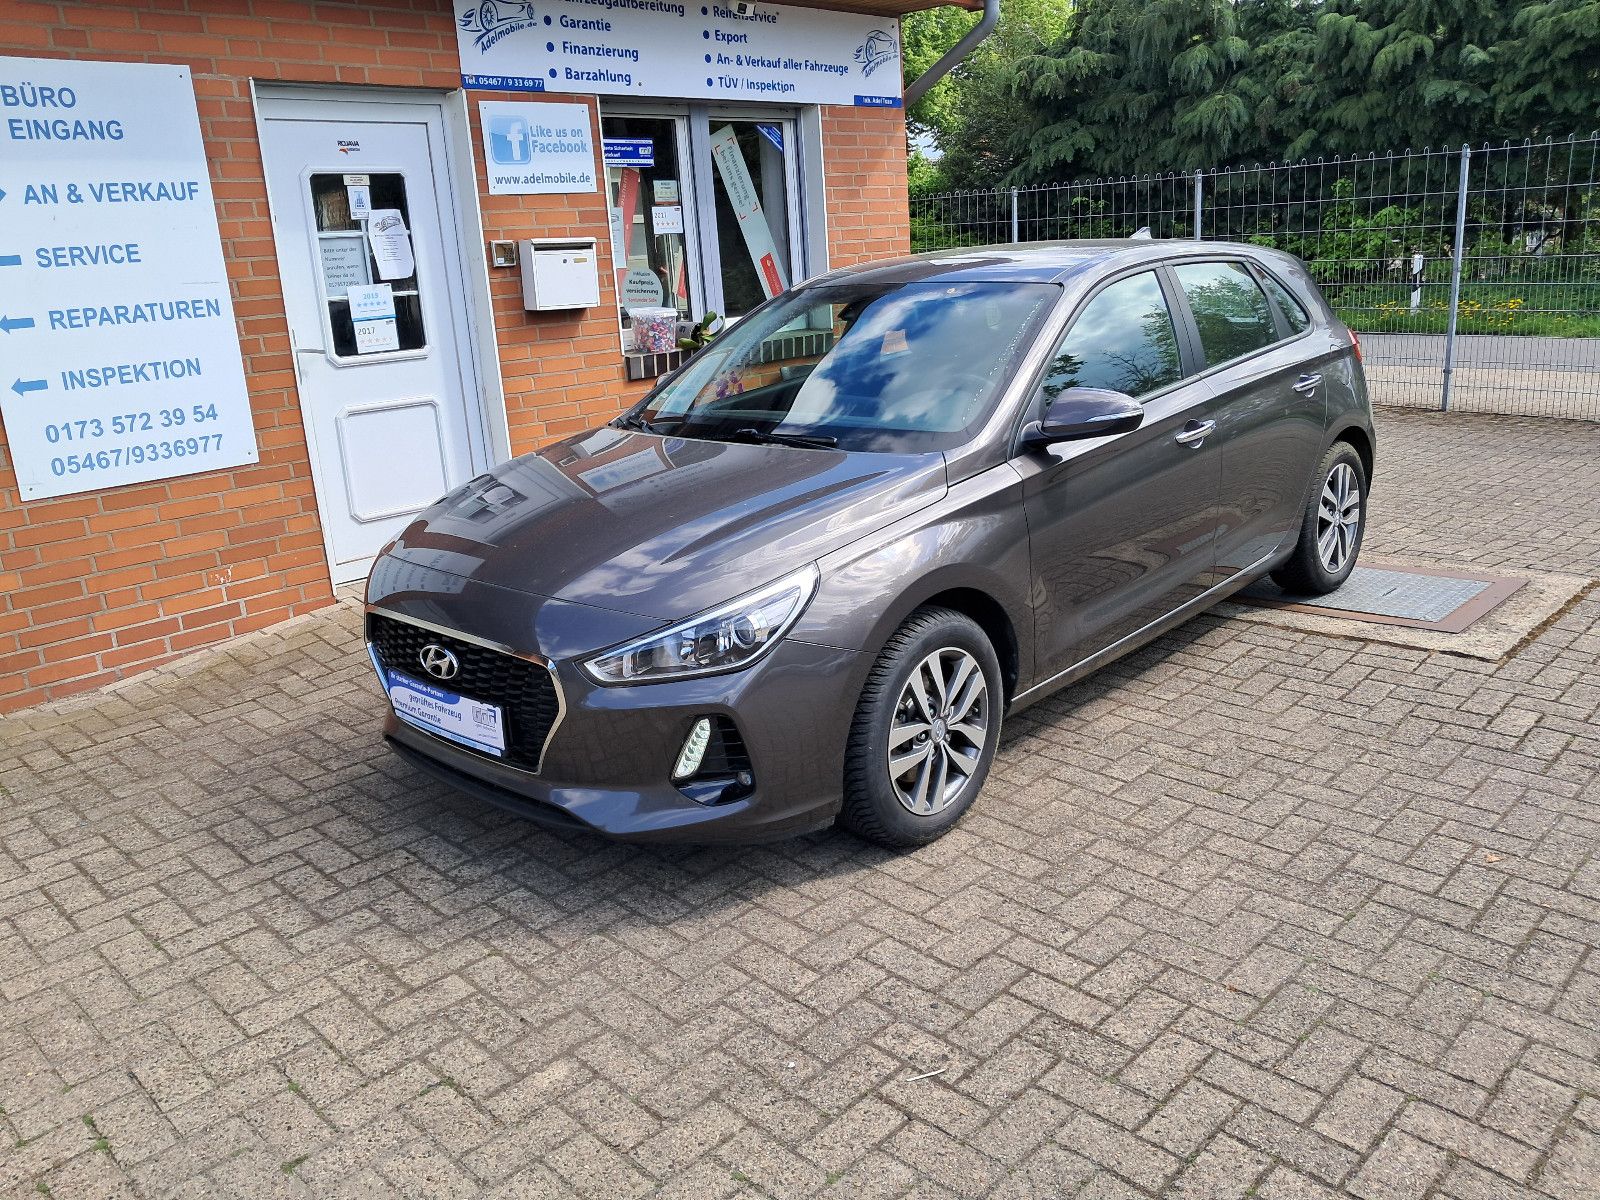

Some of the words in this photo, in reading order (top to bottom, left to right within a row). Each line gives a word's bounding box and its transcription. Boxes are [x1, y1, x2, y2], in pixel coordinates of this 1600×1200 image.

[560, 15, 611, 31] Garantie
[481, 21, 538, 55] Adelmobile.de
[715, 30, 747, 44] Export
[562, 41, 639, 62] Finanzierung
[717, 53, 734, 65] An-
[736, 54, 744, 66] &
[745, 55, 782, 69] Verkauf
[783, 58, 802, 70] aller
[805, 60, 849, 76] Fahrzeuge
[464, 76, 478, 85] Tel.
[479, 77, 502, 86] 05467
[507, 78, 513, 87] 9
[514, 79, 524, 87] 33
[524, 80, 534, 88] 69
[535, 80, 544, 88] 77
[565, 67, 632, 86] Barzahlung
[718, 75, 738, 88] TÜV
[741, 78, 745, 90] /
[747, 78, 795, 93] Inspektion
[0, 82, 77, 109] BÜRO
[8, 118, 124, 141] EINGANG
[530, 125, 553, 138] Like
[555, 128, 568, 138] us
[570, 128, 583, 138] on
[531, 140, 588, 153] Facebook
[495, 173, 591, 185] www.adelmobile.de
[23, 183, 59, 205] AN
[66, 182, 84, 204] &
[88, 181, 199, 203] VERKAUF
[35, 243, 142, 268] SERVICE
[626, 288, 659, 296] versicherung
[48, 298, 221, 331] REPARATUREN
[358, 326, 376, 336] 2017
[61, 357, 202, 391] INSPEKTION
[45, 415, 104, 444] 0173
[112, 411, 152, 435] 572
[159, 408, 186, 428] 39
[193, 403, 218, 424] 54
[50, 433, 224, 477] 05467/9336977
[394, 697, 417, 715] Premium
[417, 707, 442, 725] Garantie
[408, 693, 435, 710] geprüftes
